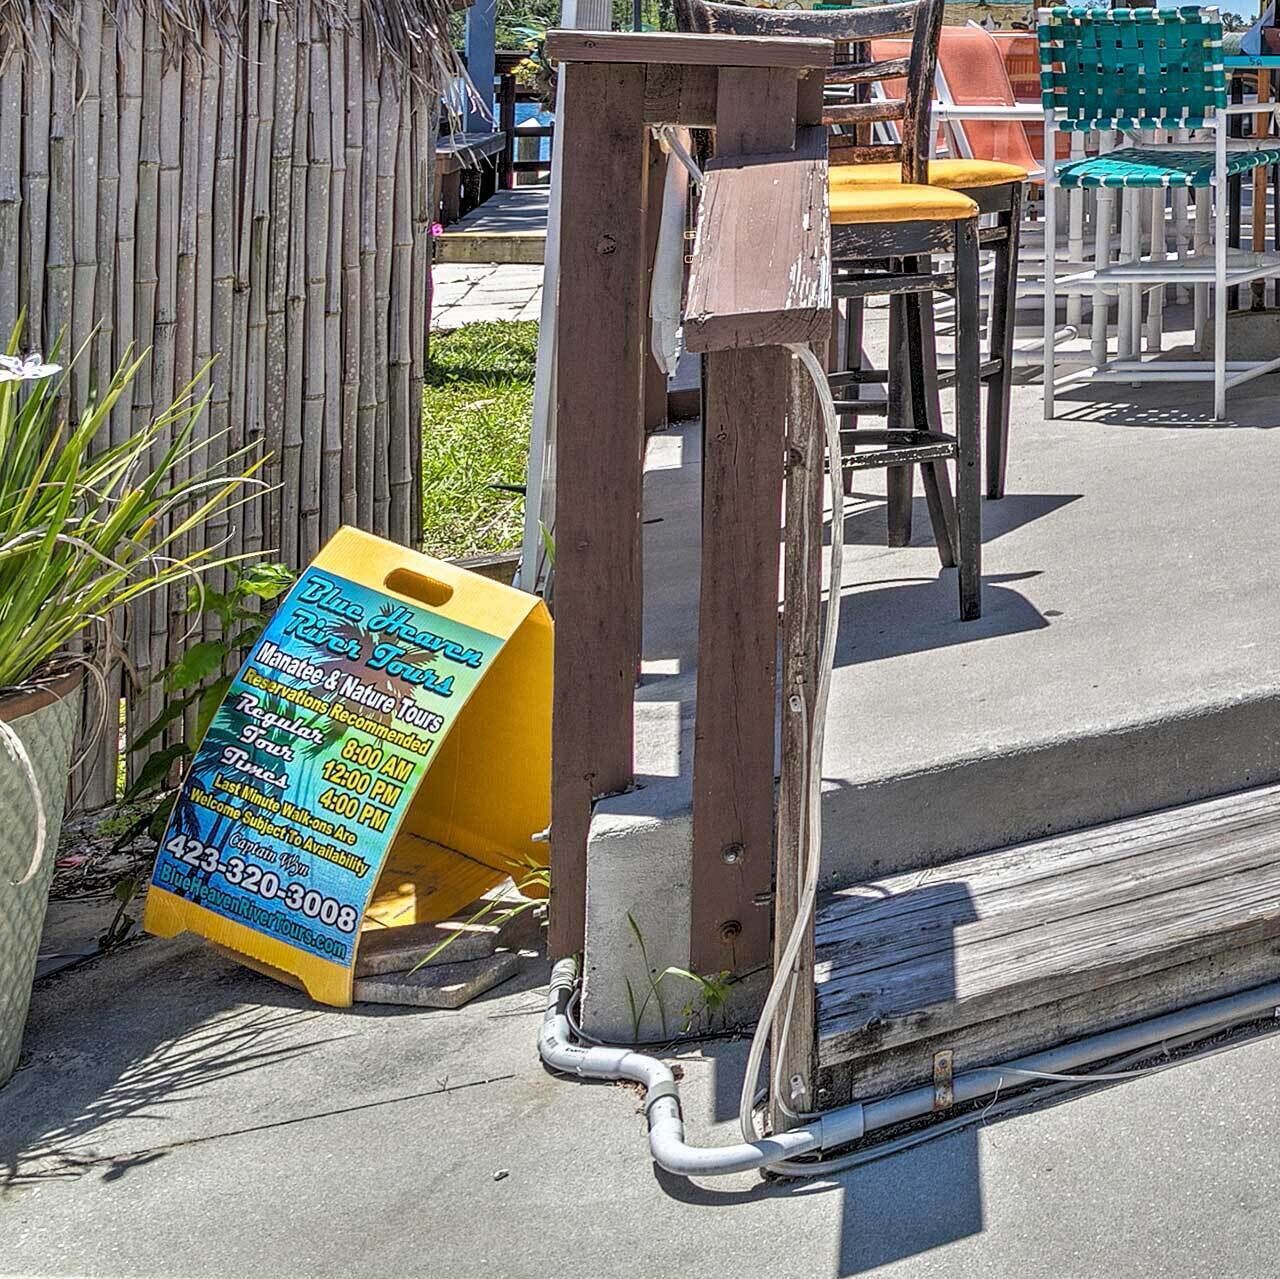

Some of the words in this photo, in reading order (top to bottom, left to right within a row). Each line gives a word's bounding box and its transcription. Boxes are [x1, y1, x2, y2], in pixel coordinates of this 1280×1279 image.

[283, 607, 362, 661] River
[366, 642, 457, 697] Tours
[298, 575, 365, 622] Blue
[366, 606, 484, 668] Heaven
[234, 692, 326, 744] Regular
[242, 667, 330, 715] Reservations
[329, 701, 433, 756] Recommended
[255, 641, 325, 687] Manatee
[324, 668, 341, 692] &
[338, 675, 398, 715] Nature
[393, 696, 445, 733] Tours
[220, 746, 290, 790] Times
[238, 723, 295, 762] Tour
[341, 737, 380, 770] 8:00
[379, 752, 417, 781] AM
[213, 773, 243, 796] Last
[240, 784, 281, 814] Minute
[280, 802, 335, 837] Walk-ons
[334, 824, 358, 845] Are
[318, 788, 359, 821] 4:00
[357, 803, 392, 832] PM
[321, 760, 370, 796] 12:00
[370, 776, 404, 809] PM
[188, 786, 242, 820] Welcome
[242, 809, 287, 843] Subject
[286, 828, 304, 847] To
[302, 834, 371, 878] Availability
[228, 832, 277, 865] Captain
[278, 852, 310, 877] Wyn
[158, 863, 348, 959] BlueHeavenRiverTours.com
[164, 833, 358, 934] 423-320-3008
